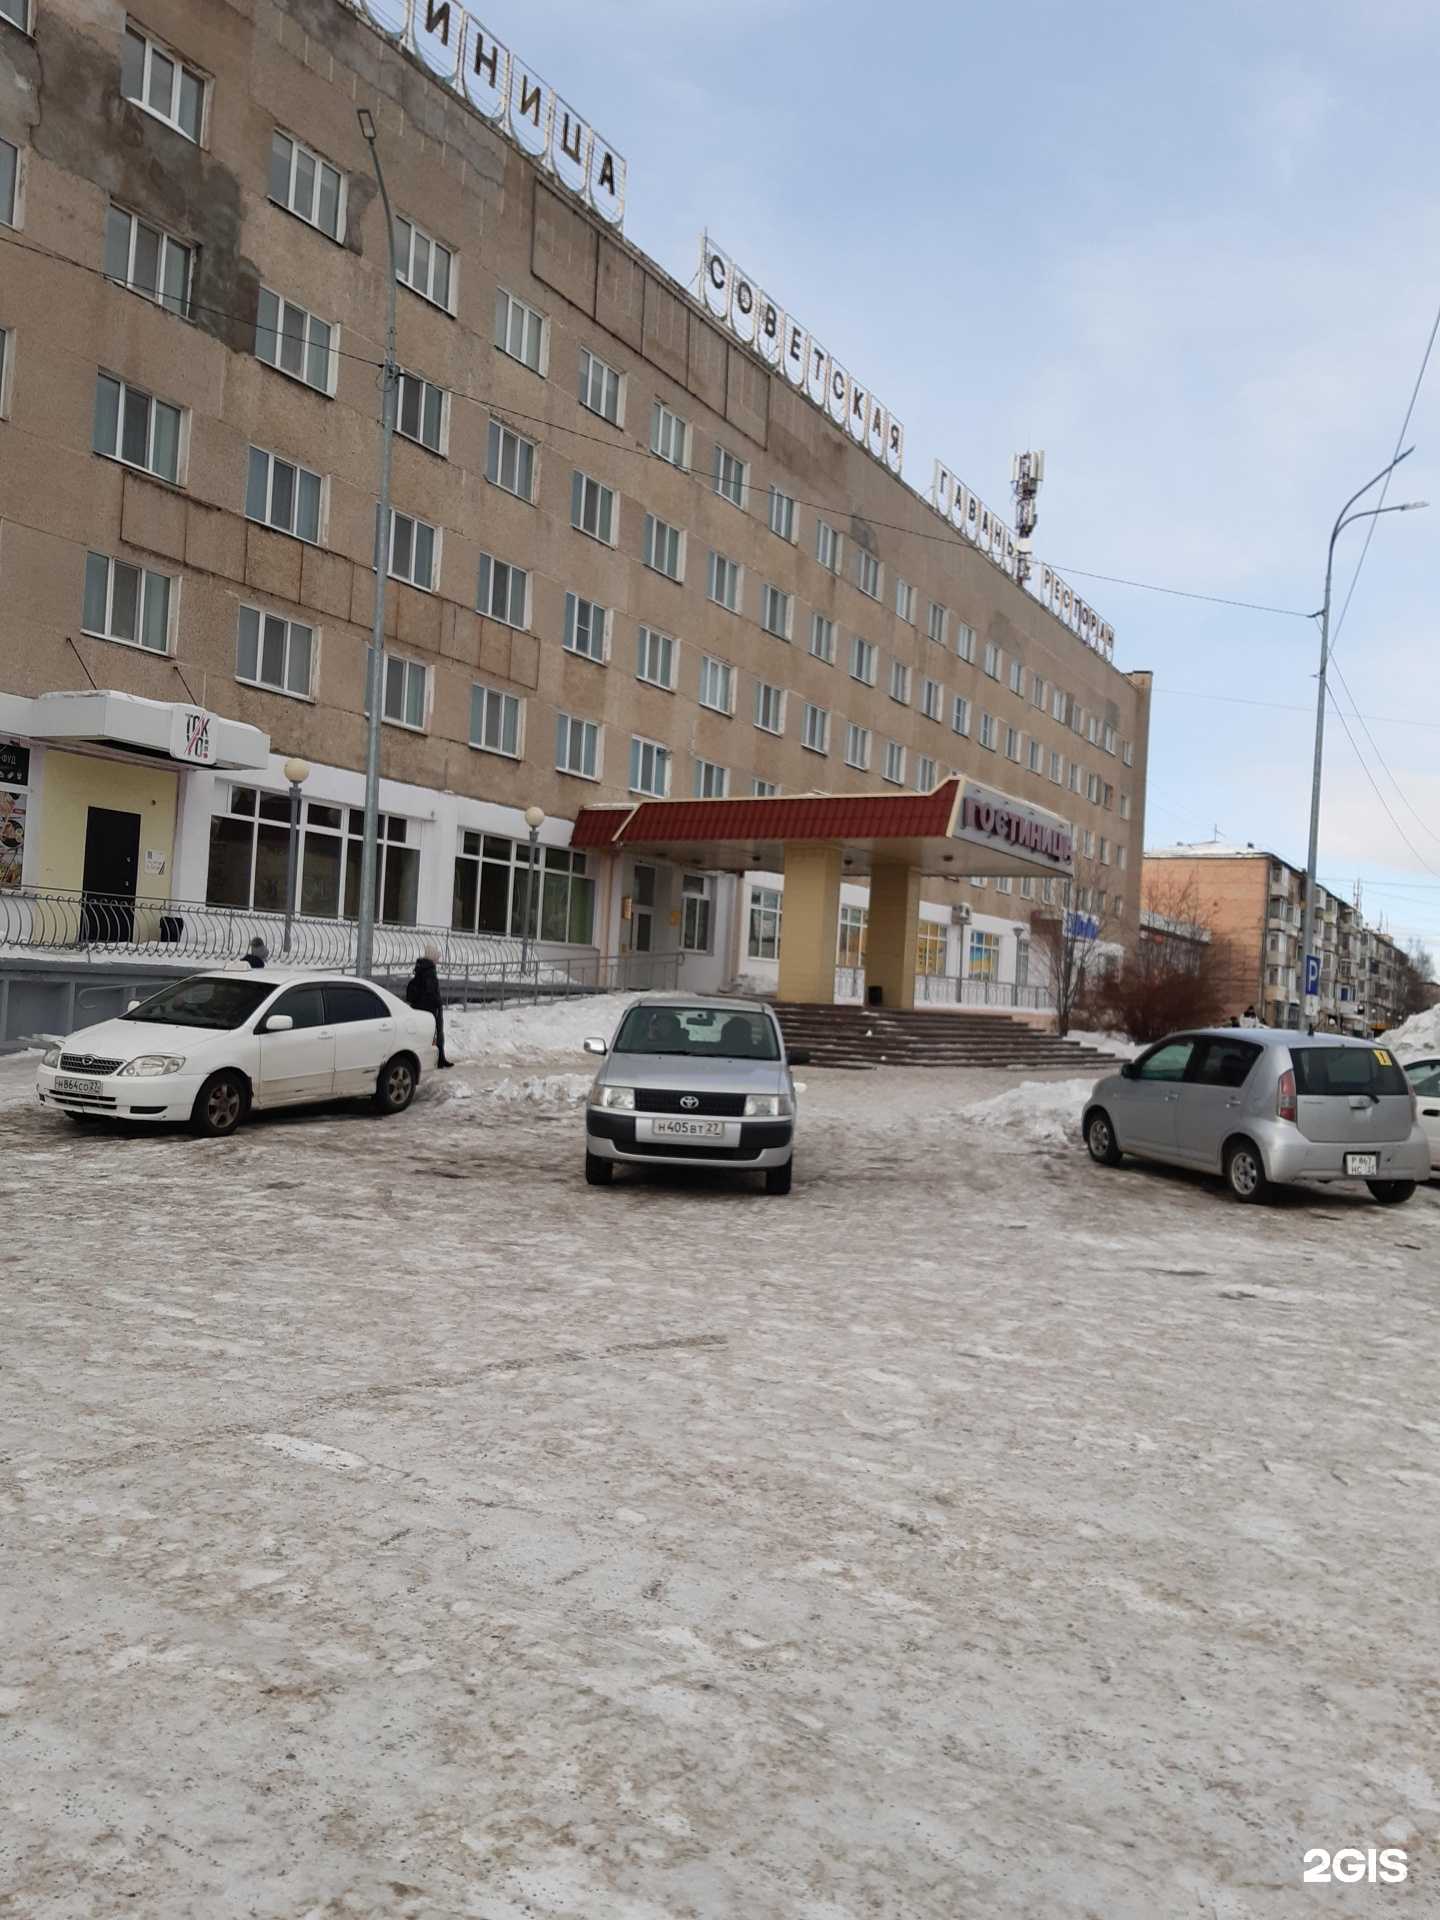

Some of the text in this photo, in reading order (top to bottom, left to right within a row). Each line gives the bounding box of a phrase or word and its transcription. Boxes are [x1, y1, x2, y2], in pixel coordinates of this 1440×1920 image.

[709, 254, 900, 454] СОВЕТСКАЯ
[940, 469, 1015, 556] ГАВАНЬ
[963, 796, 1073, 864] ГОСТИНИЦА
